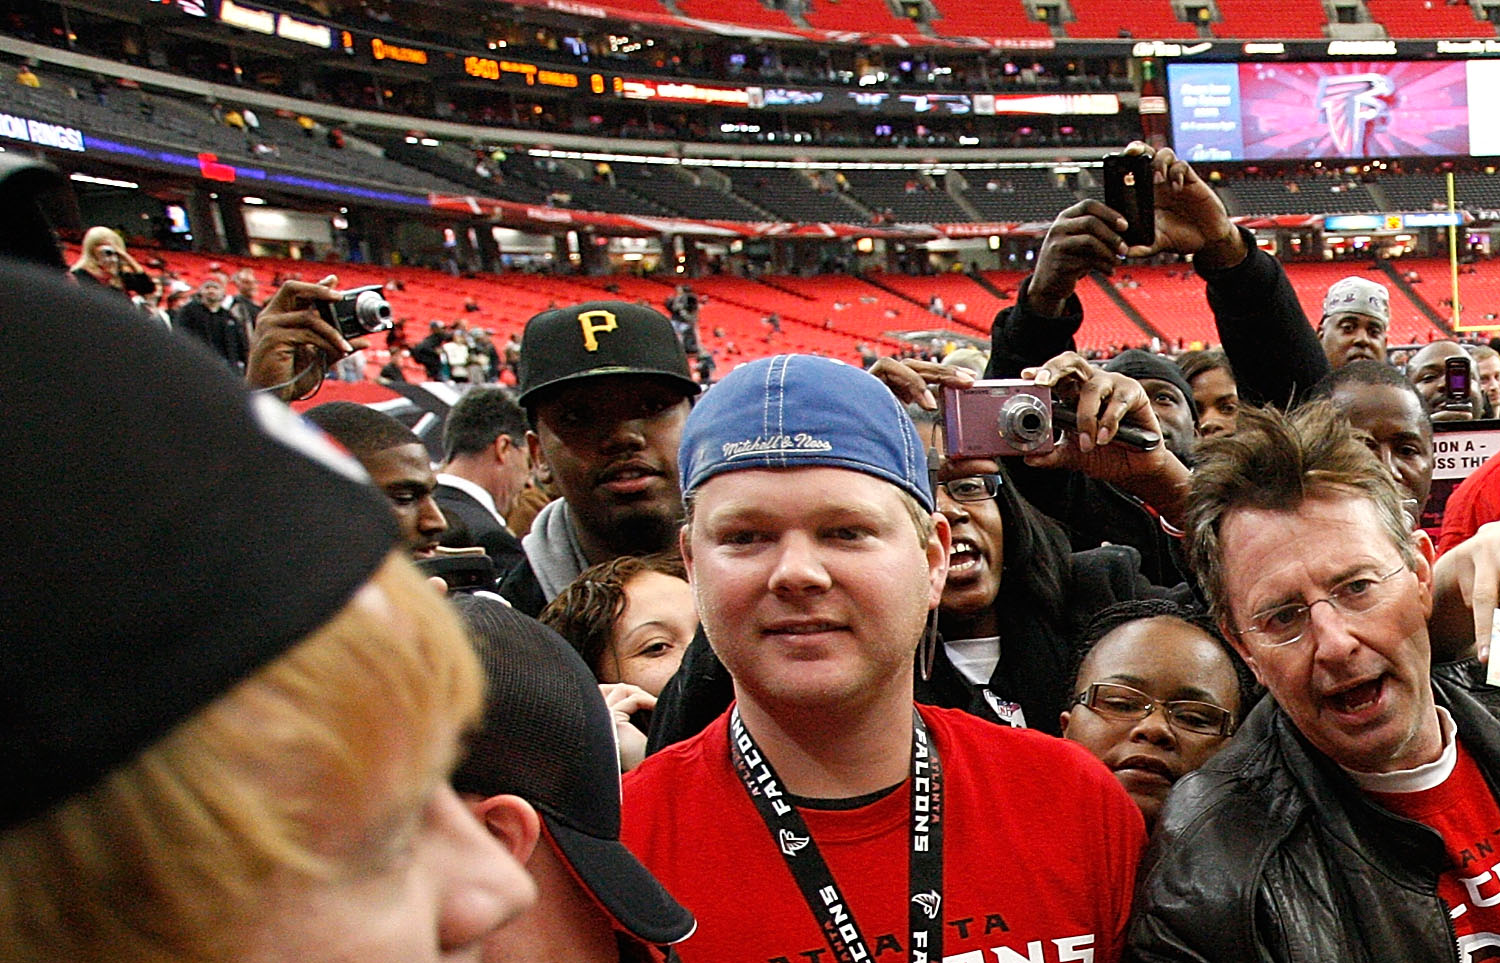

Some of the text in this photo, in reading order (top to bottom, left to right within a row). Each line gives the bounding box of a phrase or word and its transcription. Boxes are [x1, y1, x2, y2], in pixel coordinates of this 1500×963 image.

[577, 309, 619, 352] P
[722, 436, 782, 457] Mitchell
[794, 433, 833, 450] Ness
[1464, 441, 1475, 452] A
[914, 727, 930, 853] FALCONS
